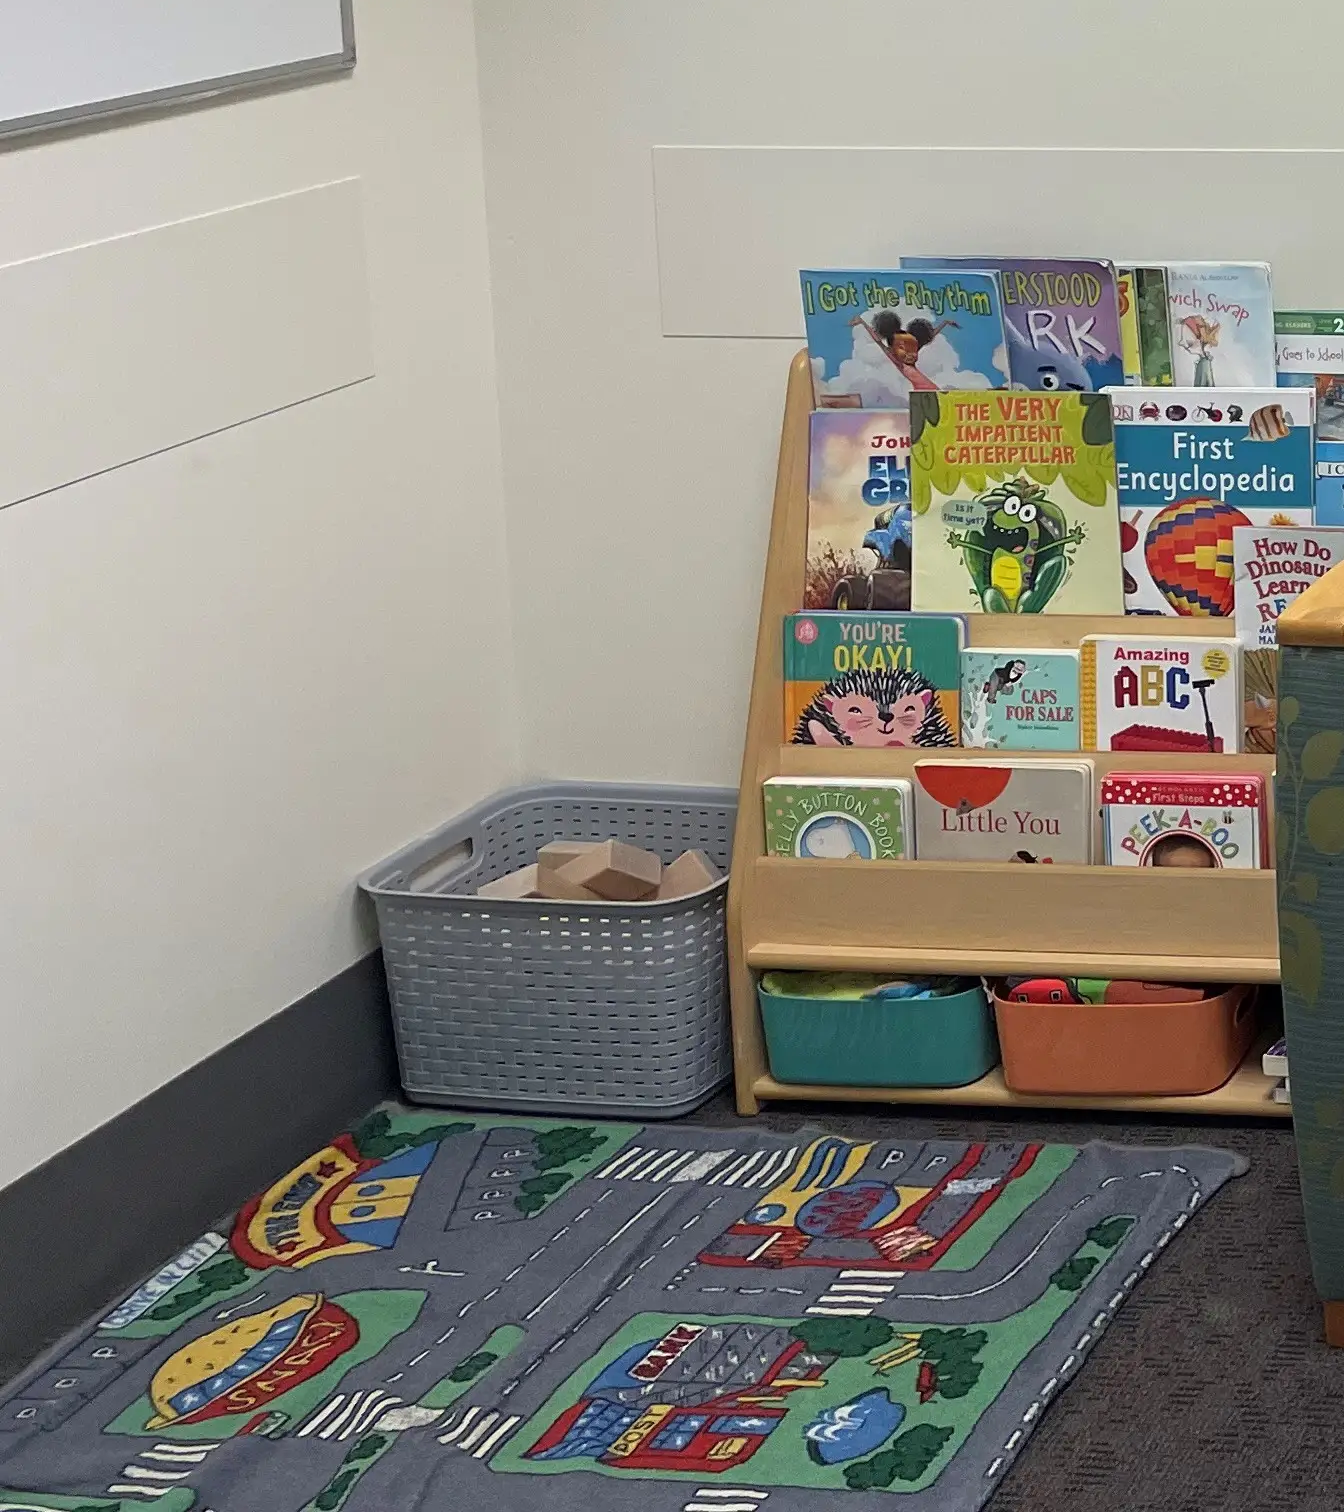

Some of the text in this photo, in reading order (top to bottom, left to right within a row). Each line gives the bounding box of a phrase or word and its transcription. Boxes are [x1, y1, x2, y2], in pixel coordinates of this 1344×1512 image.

[805, 279, 992, 317] I Got the Rhythm
[1206, 293, 1249, 327] Swap
[1333, 318, 1344, 333] 2
[1305, 348, 1315, 360] to
[1317, 347, 1344, 362] School
[955, 396, 1062, 422] THE VERY
[955, 424, 1063, 444] IMPATIENT
[1173, 432, 1235, 460] First
[944, 446, 1076, 465] CATERPILLAR
[1327, 464, 1332, 474] I
[1117, 463, 1295, 502] Encyclopedia
[1252, 537, 1331, 561] How Do
[839, 620, 907, 644] YOU'RE
[834, 645, 913, 672] OKAY!
[1114, 646, 1190, 665] Amazing
[1021, 689, 1057, 704] CAPS
[1113, 665, 1190, 710] ABC
[1006, 705, 1074, 722] FOR SALE
[798, 792, 868, 816] BUTTON
[869, 812, 896, 859] BOOK
[941, 808, 1061, 835] Little You
[880, 1150, 905, 1169] P
[923, 1155, 948, 1170] P
[613, 1409, 667, 1454] POST
